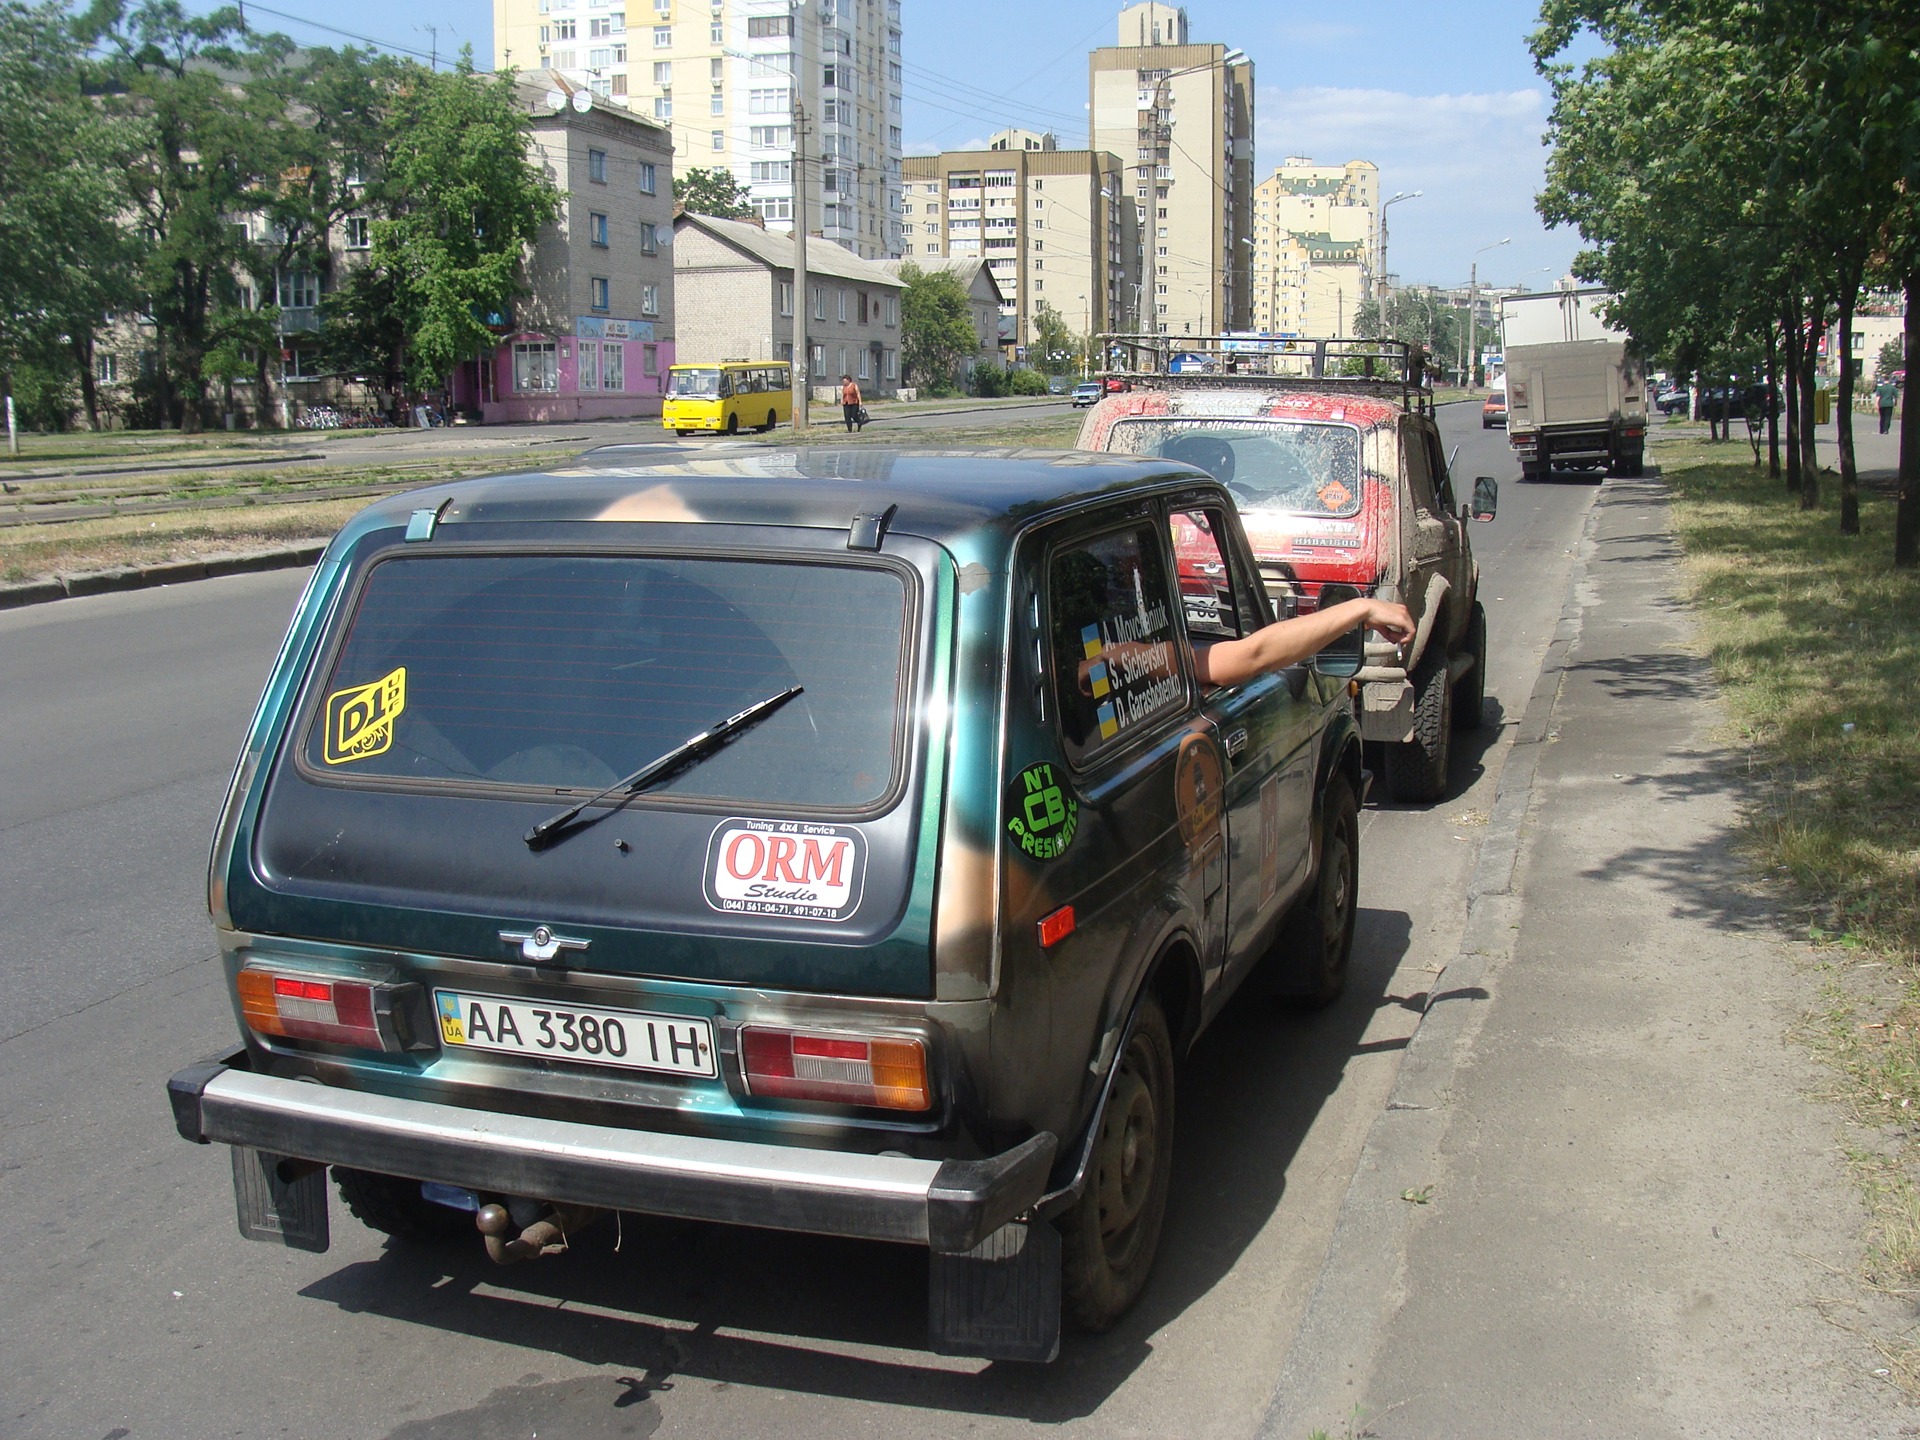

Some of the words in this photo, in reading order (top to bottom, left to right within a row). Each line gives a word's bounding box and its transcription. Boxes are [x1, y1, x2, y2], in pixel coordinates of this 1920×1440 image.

[1103, 621, 1116, 652] A.
[1108, 658, 1123, 690] S.
[1115, 697, 1130, 728] D.
[746, 821, 775, 832] Tuning
[779, 823, 799, 833] 4x4
[803, 825, 836, 835] Service
[725, 833, 849, 887] ORM
[744, 884, 818, 902] Studio
[722, 899, 745, 911] (044)
[746, 902, 792, 916] 561-04-71,
[793, 906, 838, 919] 491-07-18
[446, 1025, 463, 1038] UA
[467, 1002, 524, 1046] AA
[532, 1009, 627, 1058] 3380
[646, 1022, 701, 1067] IH
